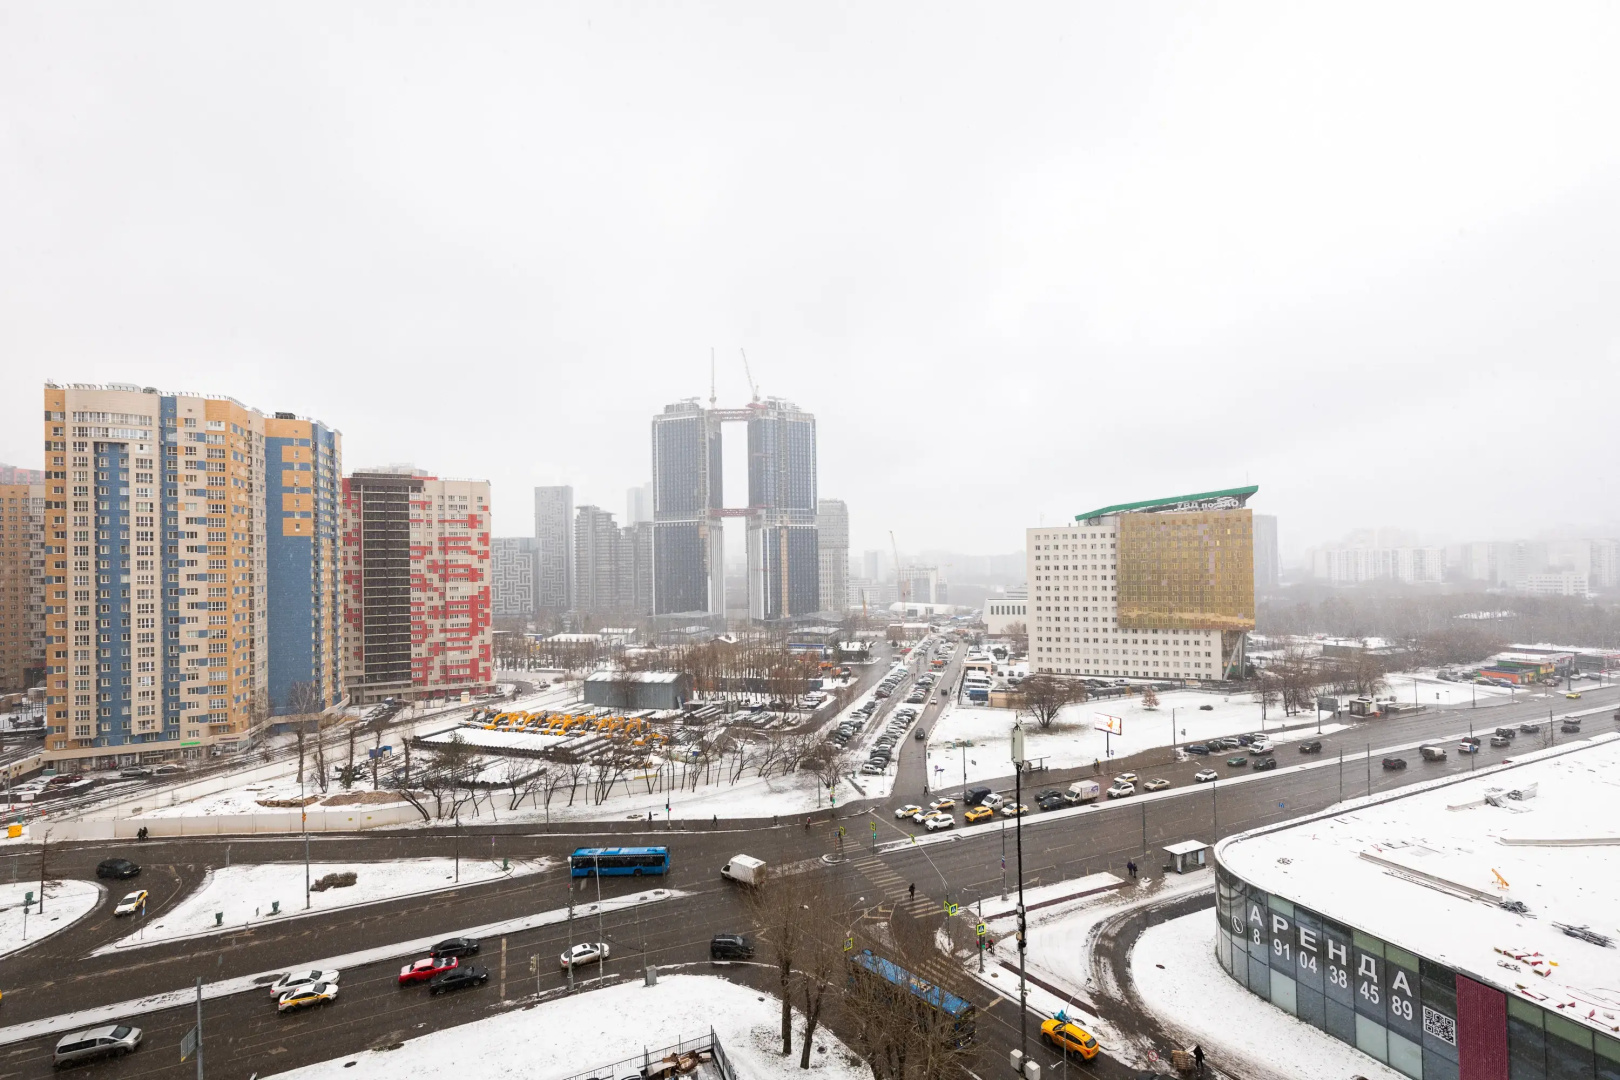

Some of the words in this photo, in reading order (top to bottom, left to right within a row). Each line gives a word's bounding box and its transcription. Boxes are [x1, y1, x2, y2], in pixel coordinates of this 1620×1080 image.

[1250, 905, 1413, 997] АРЕНДА
[1253, 928, 1260, 945] 8
[1273, 938, 1290, 960] 91
[1300, 951, 1317, 974] 04
[1329, 965, 1348, 989] 38
[1360, 981, 1379, 1005] 45
[1391, 995, 1413, 1021] 89
